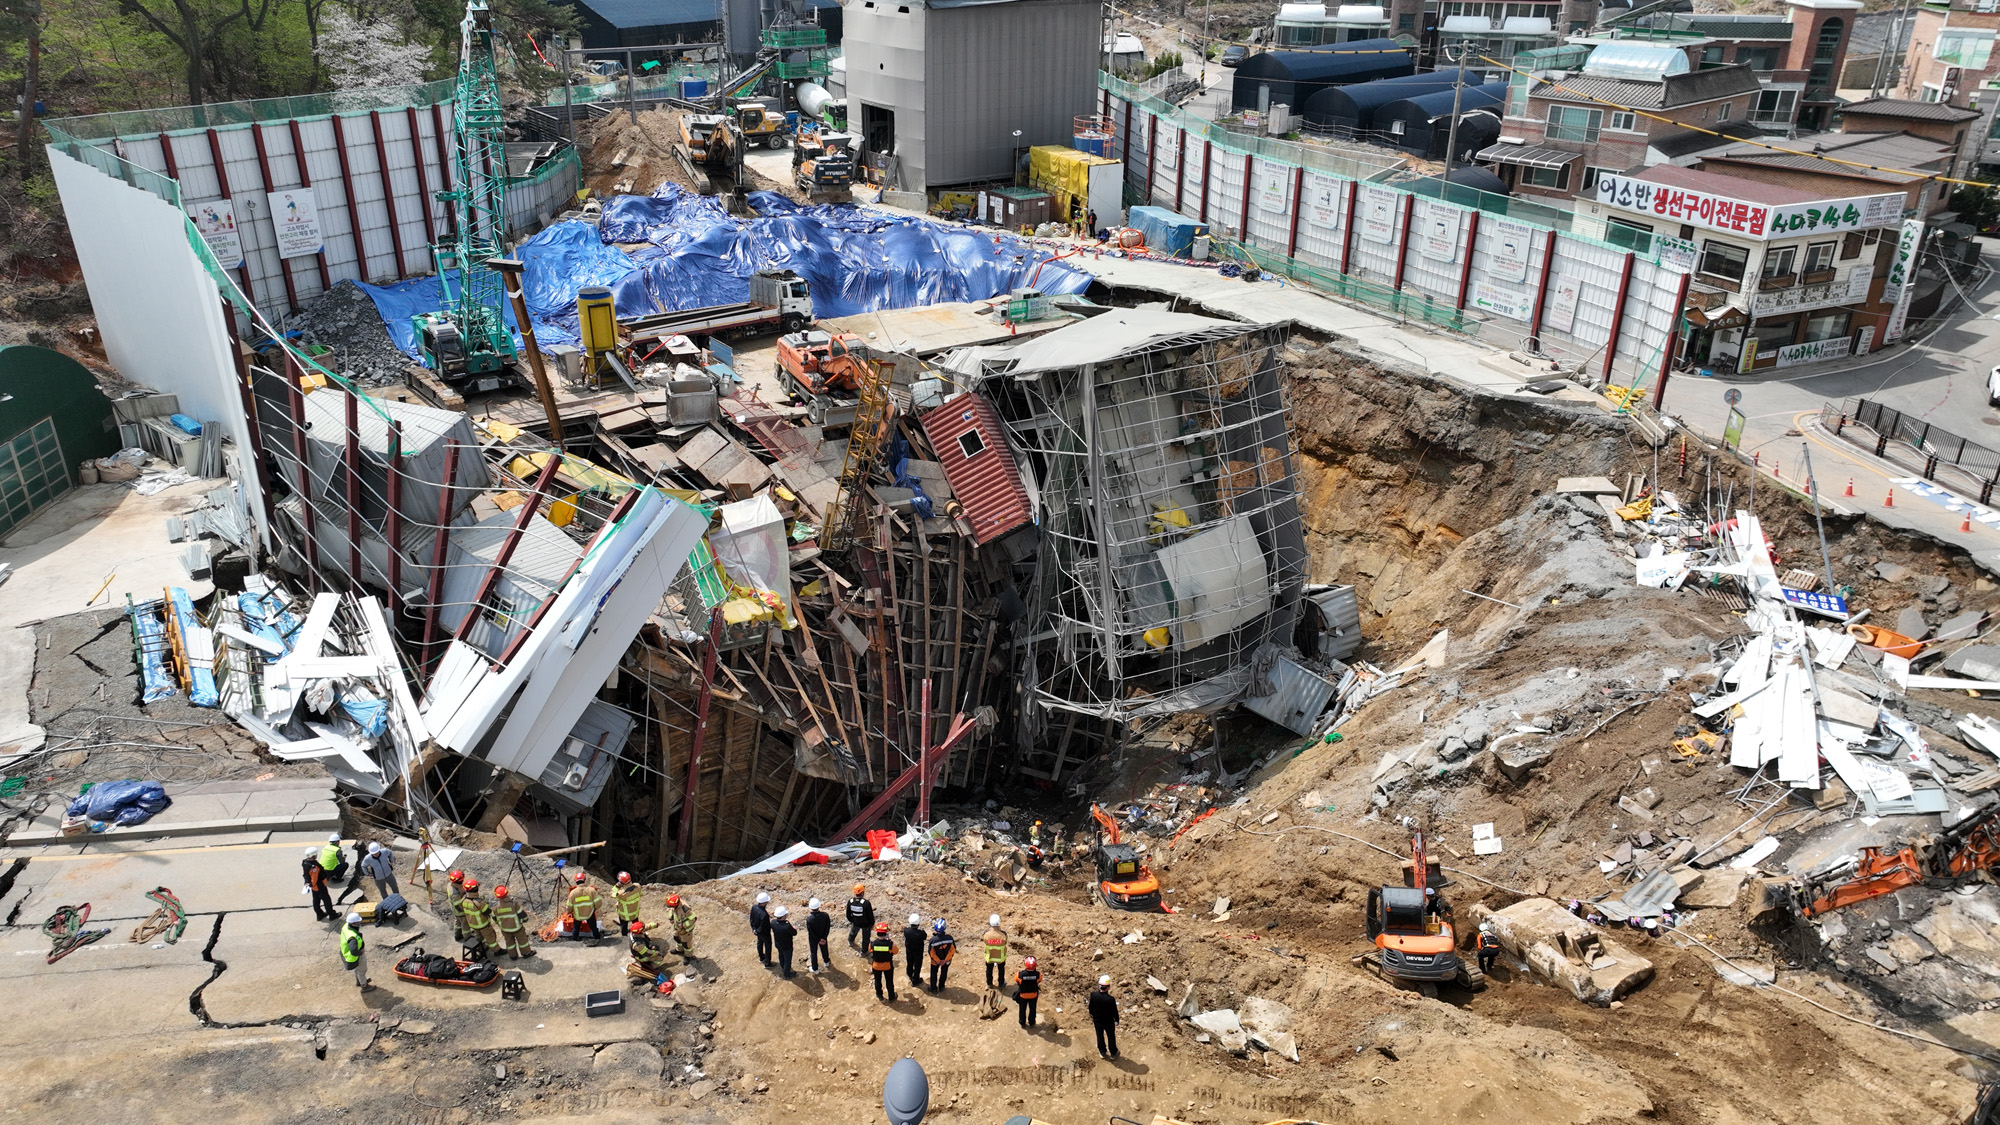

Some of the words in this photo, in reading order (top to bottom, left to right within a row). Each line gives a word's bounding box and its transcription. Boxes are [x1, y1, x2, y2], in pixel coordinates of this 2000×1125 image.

[1600, 178, 1651, 210] 어소반
[1653, 188, 1767, 236] 생선구이전문점
[286, 224, 309, 232] 고소작업시
[1493, 302, 1514, 315] 안전통로
